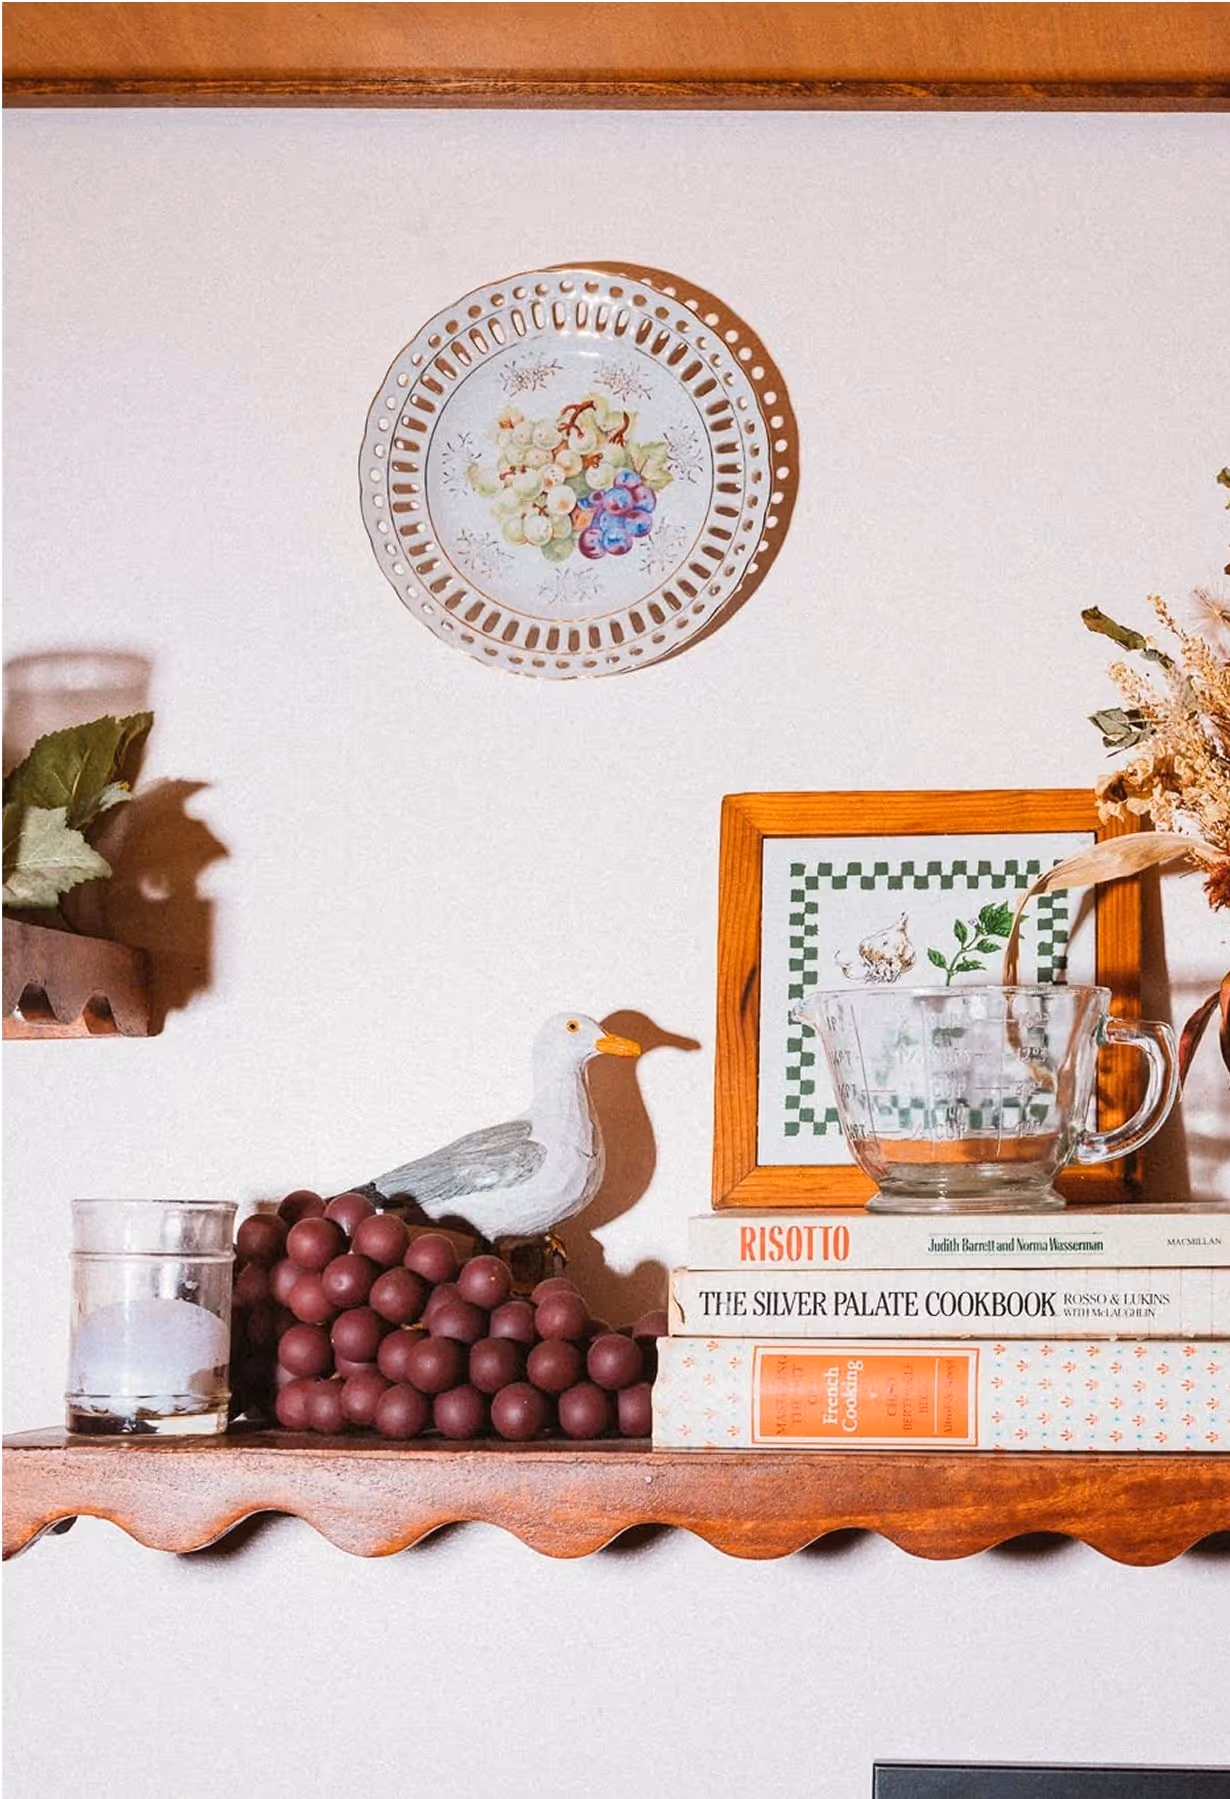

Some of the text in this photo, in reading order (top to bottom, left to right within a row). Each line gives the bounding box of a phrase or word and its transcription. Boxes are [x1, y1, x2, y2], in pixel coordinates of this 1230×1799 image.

[739, 1225, 850, 1262] RISOTTO
[927, 1236, 1104, 1253] Judith Barrett and Norma Wasserman
[1166, 1237, 1222, 1247] MACMILLAN
[699, 1290, 1057, 1318] THE SILVER PALATE COOKBOOK
[1063, 1293, 1170, 1305] ROSSO & LUKINS
[1063, 1307, 1157, 1318] WITH McLAUGHLIN
[822, 1366, 840, 1425] French
[841, 1359, 865, 1433] Cooking
